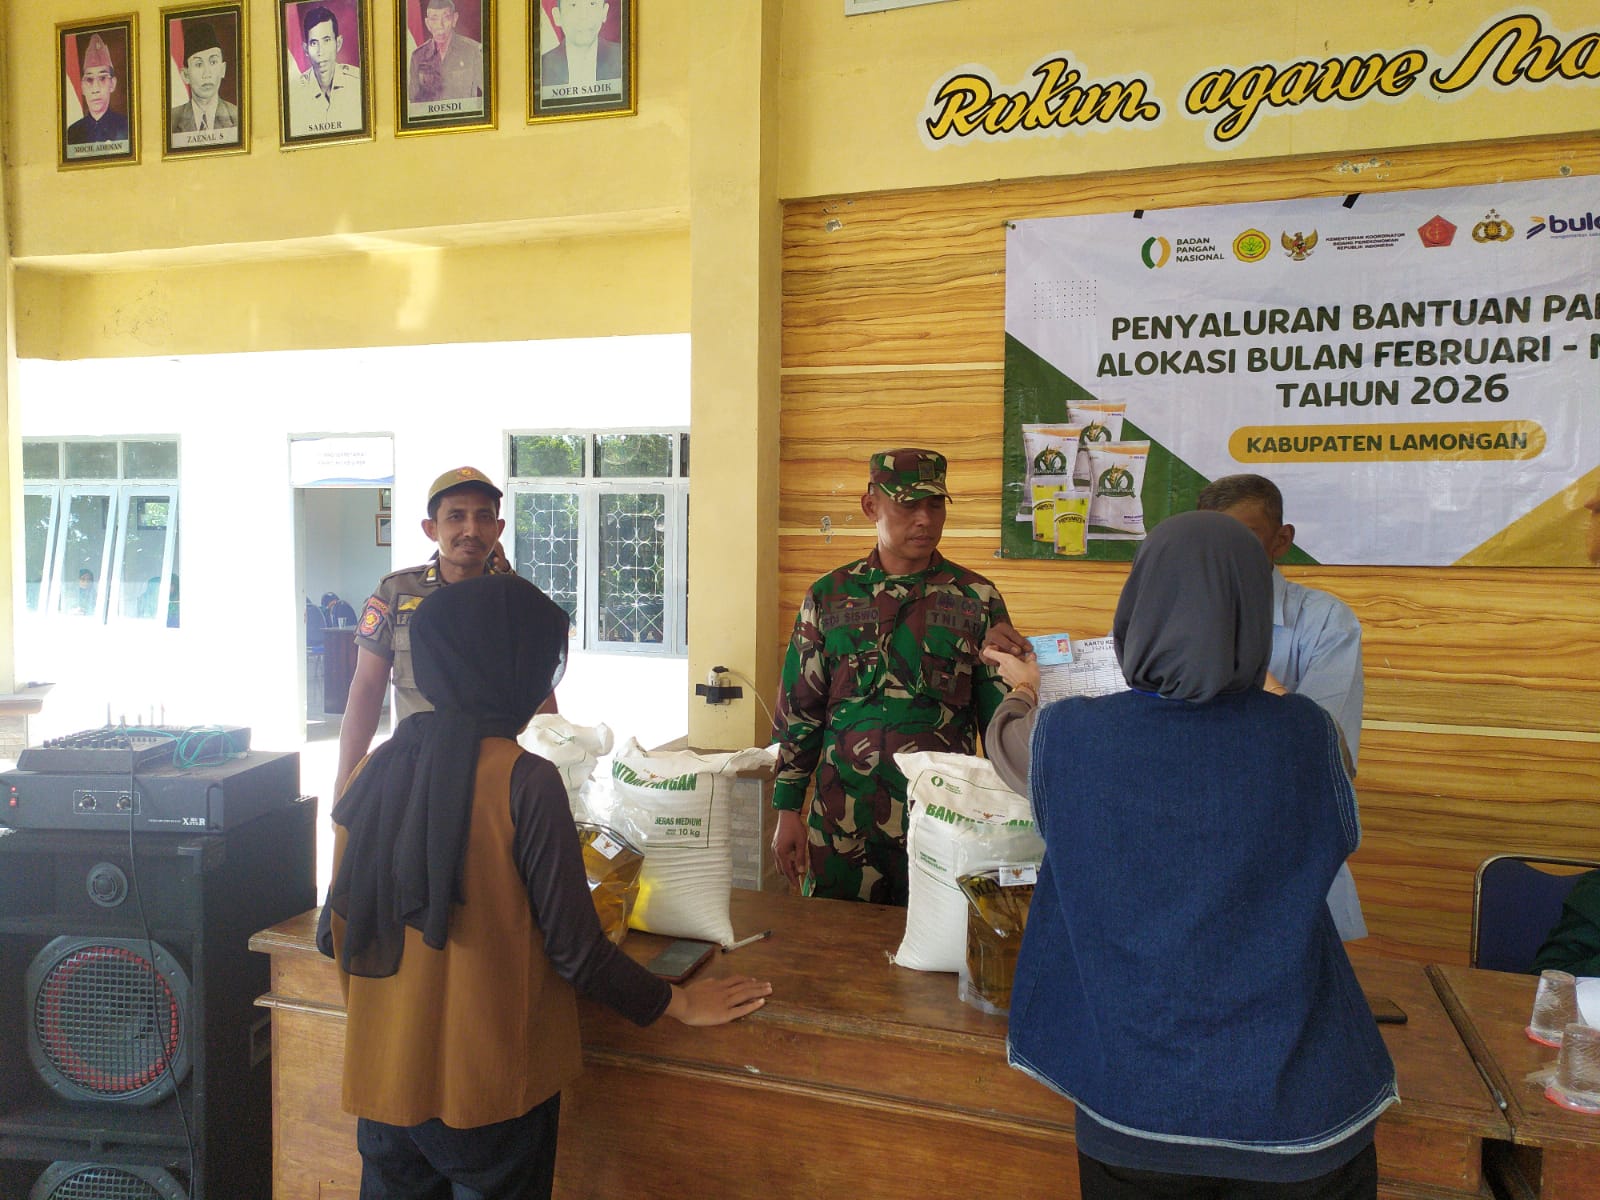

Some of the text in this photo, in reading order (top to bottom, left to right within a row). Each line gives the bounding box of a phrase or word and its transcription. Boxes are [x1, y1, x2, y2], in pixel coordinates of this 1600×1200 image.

[552, 82, 612, 97] NOER SADIK
[1185, 50, 1428, 142] agawe
[428, 102, 462, 113] ROESDI
[308, 121, 342, 131] SAKOER
[186, 133, 217, 144] ZAENAL
[1176, 237, 1210, 245] BADAN
[1176, 245, 1216, 253] PANGAN
[1176, 253, 1224, 263] NASIONAL
[1111, 305, 1341, 341] PENYALURAN
[1352, 296, 1532, 331] BANTUAN
[1096, 348, 1236, 377] ALOKASI
[1247, 343, 1363, 373] BULAN
[1374, 335, 1550, 367] FEBRUARI
[1275, 373, 1509, 408] TAHUN 2026
[1247, 432, 1528, 453] KABUPATEN LAMONGAN
[931, 611, 956, 627] TNI
[675, 817, 702, 827] MEDIUM
[689, 828, 701, 838] kg
